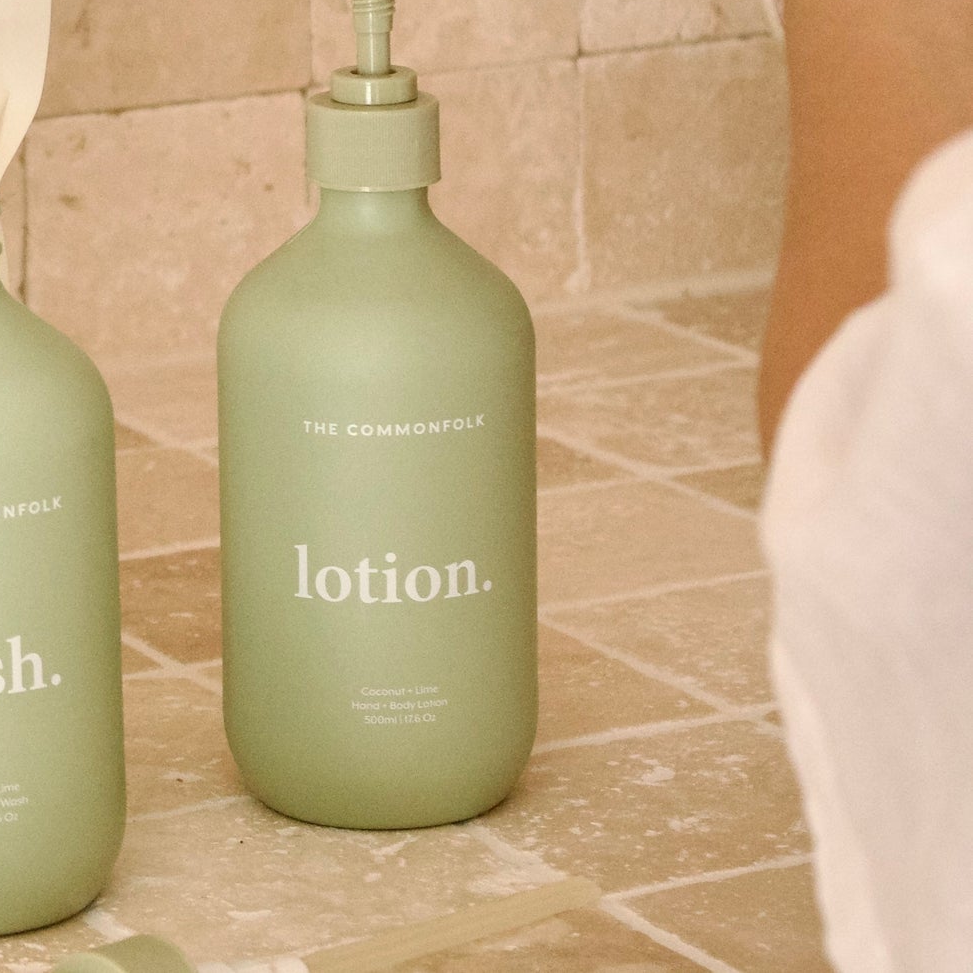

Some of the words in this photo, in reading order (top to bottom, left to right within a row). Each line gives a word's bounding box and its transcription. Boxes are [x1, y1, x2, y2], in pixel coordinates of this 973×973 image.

[303, 419, 339, 437] THE
[347, 414, 486, 437] COMMONFOLK
[293, 543, 493, 605] lotion.
[361, 687, 405, 697] Coconut
[415, 685, 439, 695] Lime
[351, 701, 381, 711] Hand
[389, 701, 416, 712] Body
[418, 698, 449, 709] Lotion
[0, 795, 29, 807] Wash
